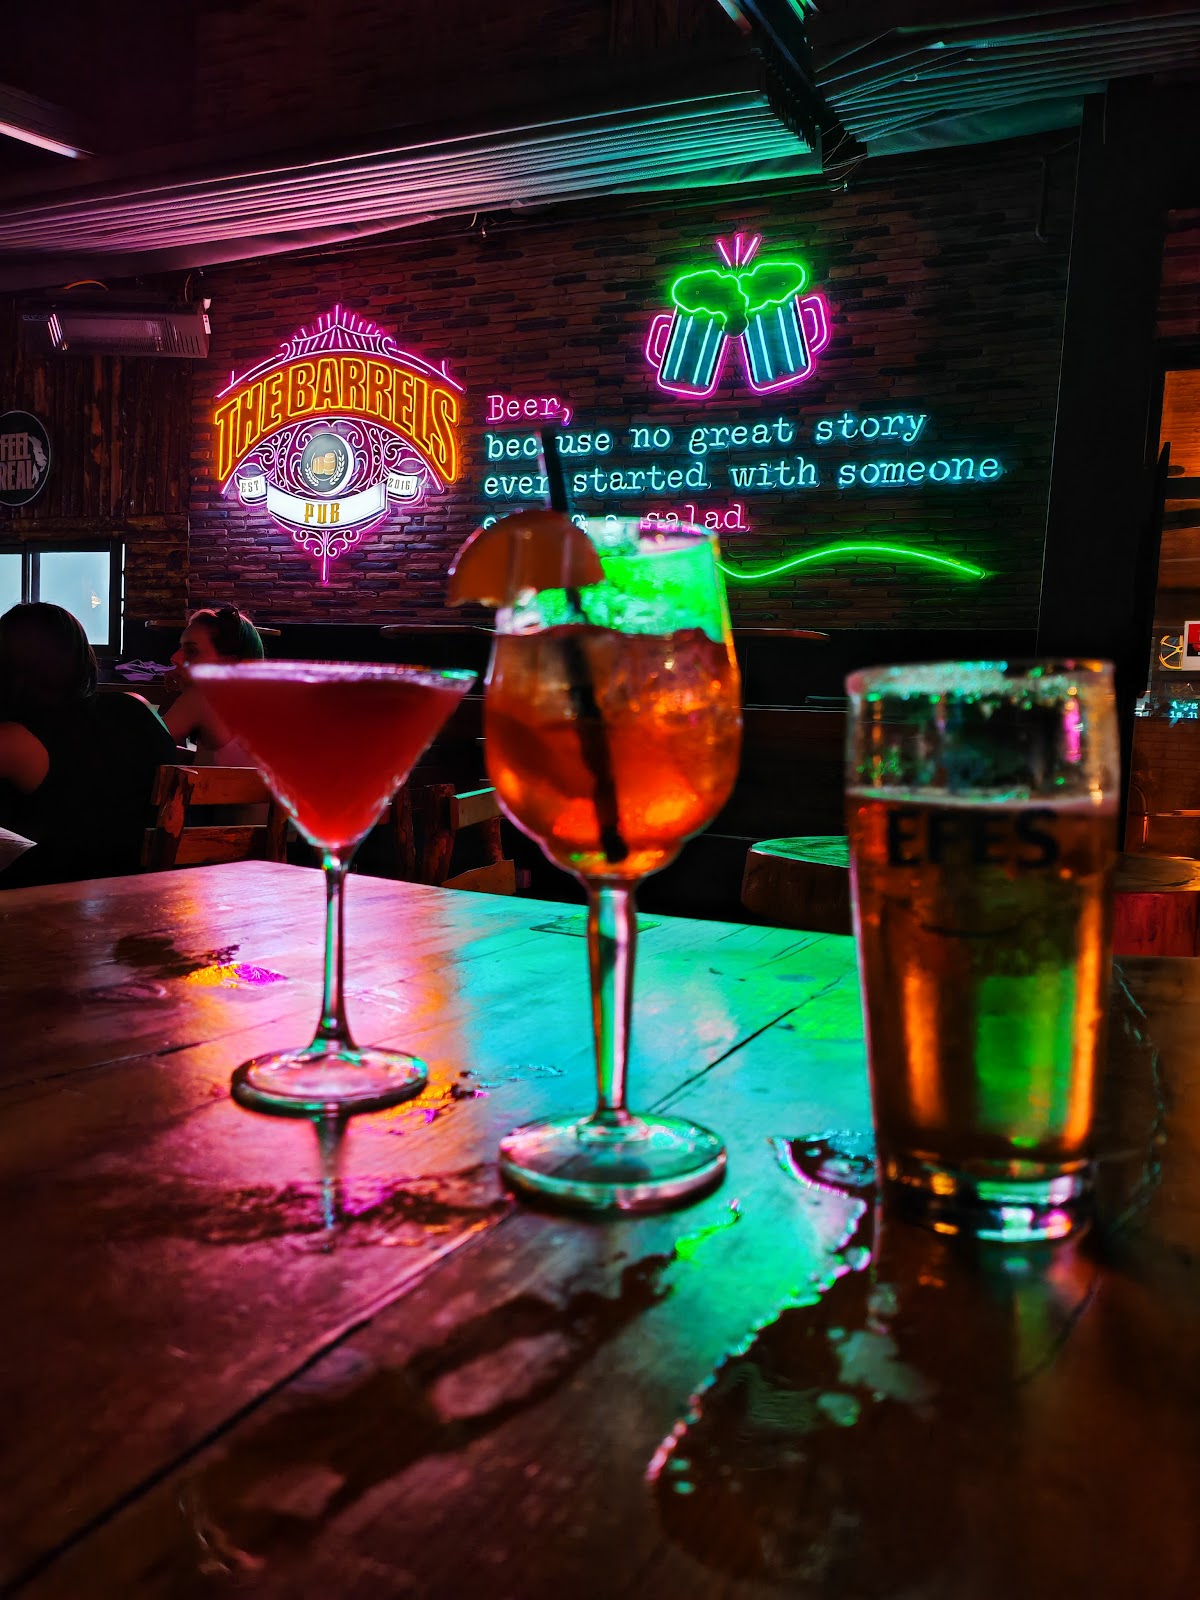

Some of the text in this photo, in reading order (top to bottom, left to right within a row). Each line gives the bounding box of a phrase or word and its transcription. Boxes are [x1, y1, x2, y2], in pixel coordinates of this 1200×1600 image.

[214, 357, 460, 484] THE BARRELS
[486, 394, 572, 426] Beer,
[0, 432, 32, 460] FEEL
[485, 412, 927, 459] becuse no great story
[0, 460, 35, 490] REAL
[241, 480, 260, 493] EST
[388, 477, 411, 491] 2016
[573, 462, 710, 493] started
[730, 457, 818, 487] with
[838, 457, 1000, 486] someone
[303, 502, 341, 525] PUB
[887, 807, 1061, 868] EFES
